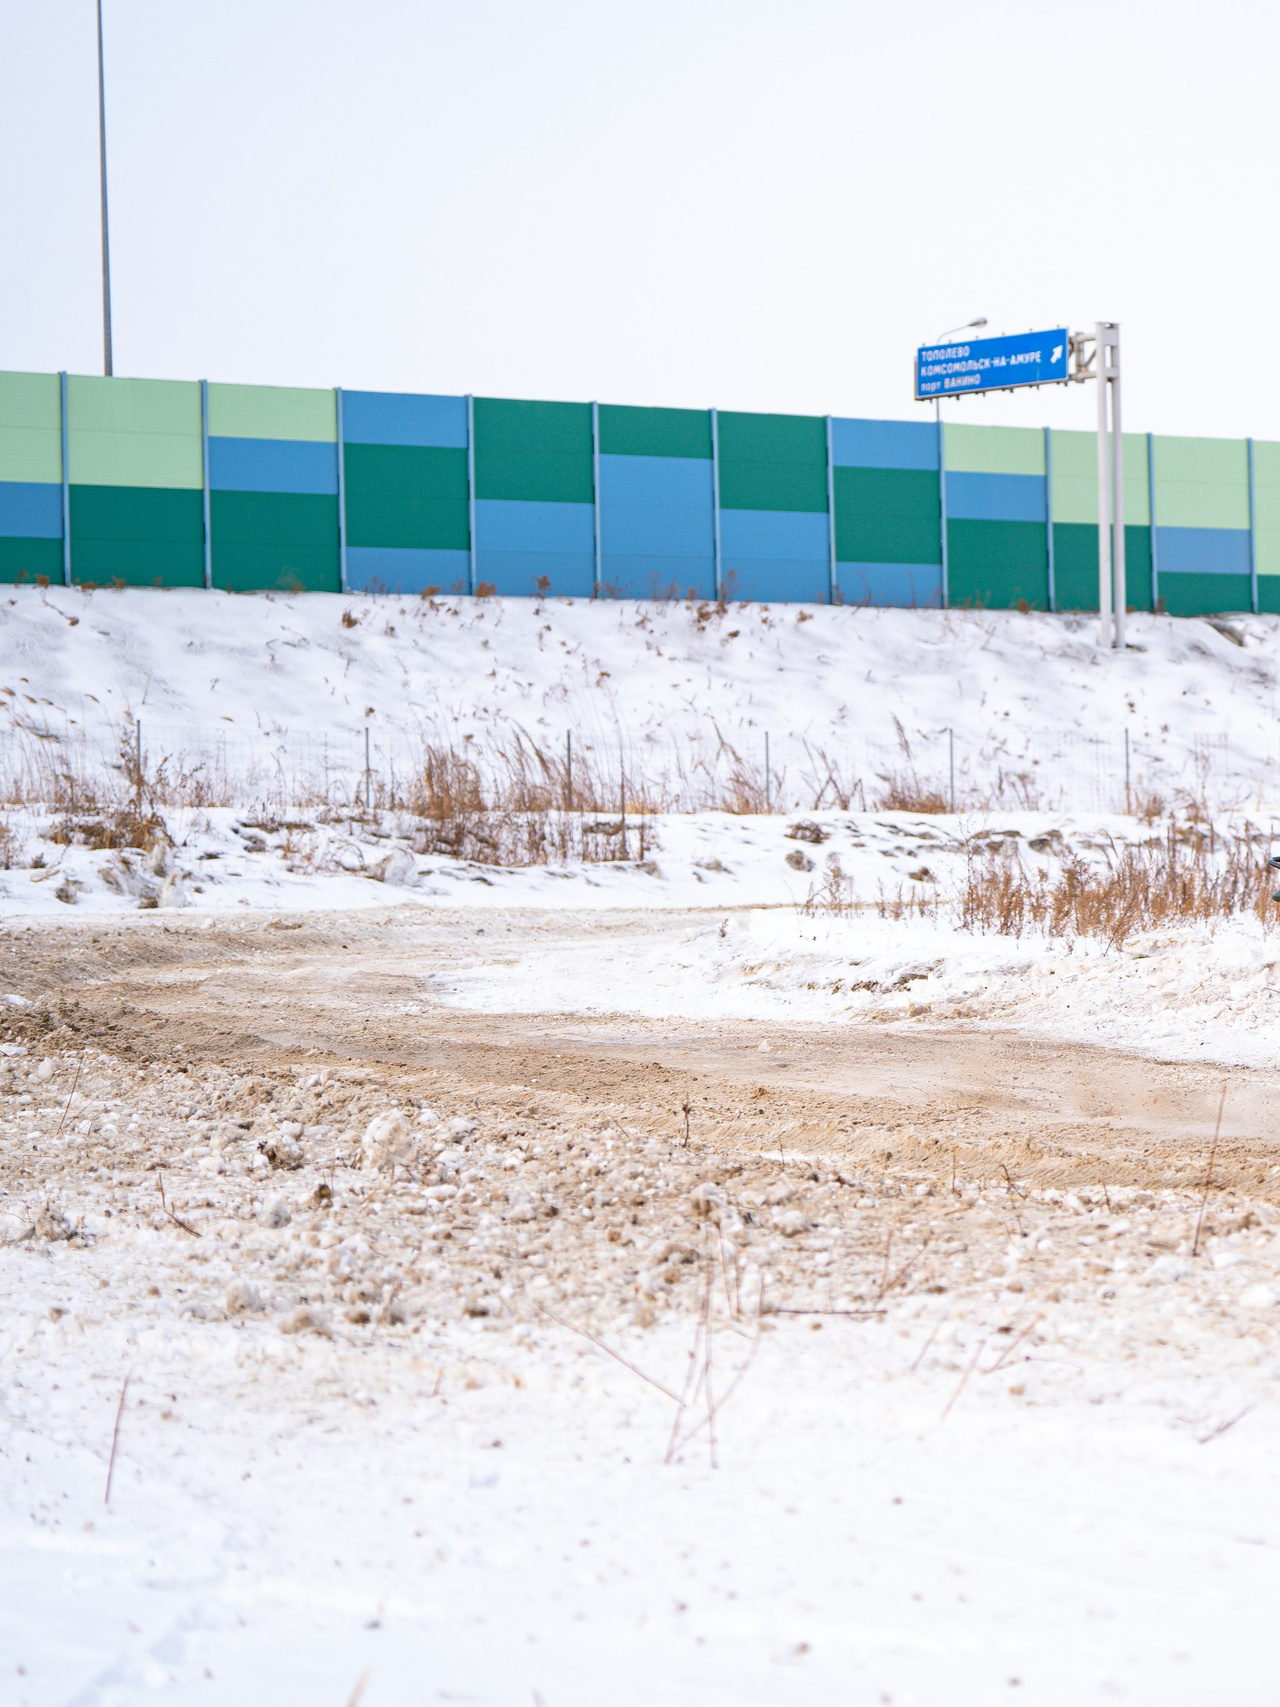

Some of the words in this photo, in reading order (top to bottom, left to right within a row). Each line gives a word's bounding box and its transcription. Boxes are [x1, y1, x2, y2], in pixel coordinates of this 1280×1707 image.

[921, 345, 970, 361] ТОПОЛЕВО
[921, 351, 1041, 376] КОМСОМОЛЬСК-НА-АМУРЕ
[921, 381, 941, 392] порт
[944, 374, 981, 389] ВАНИНО
